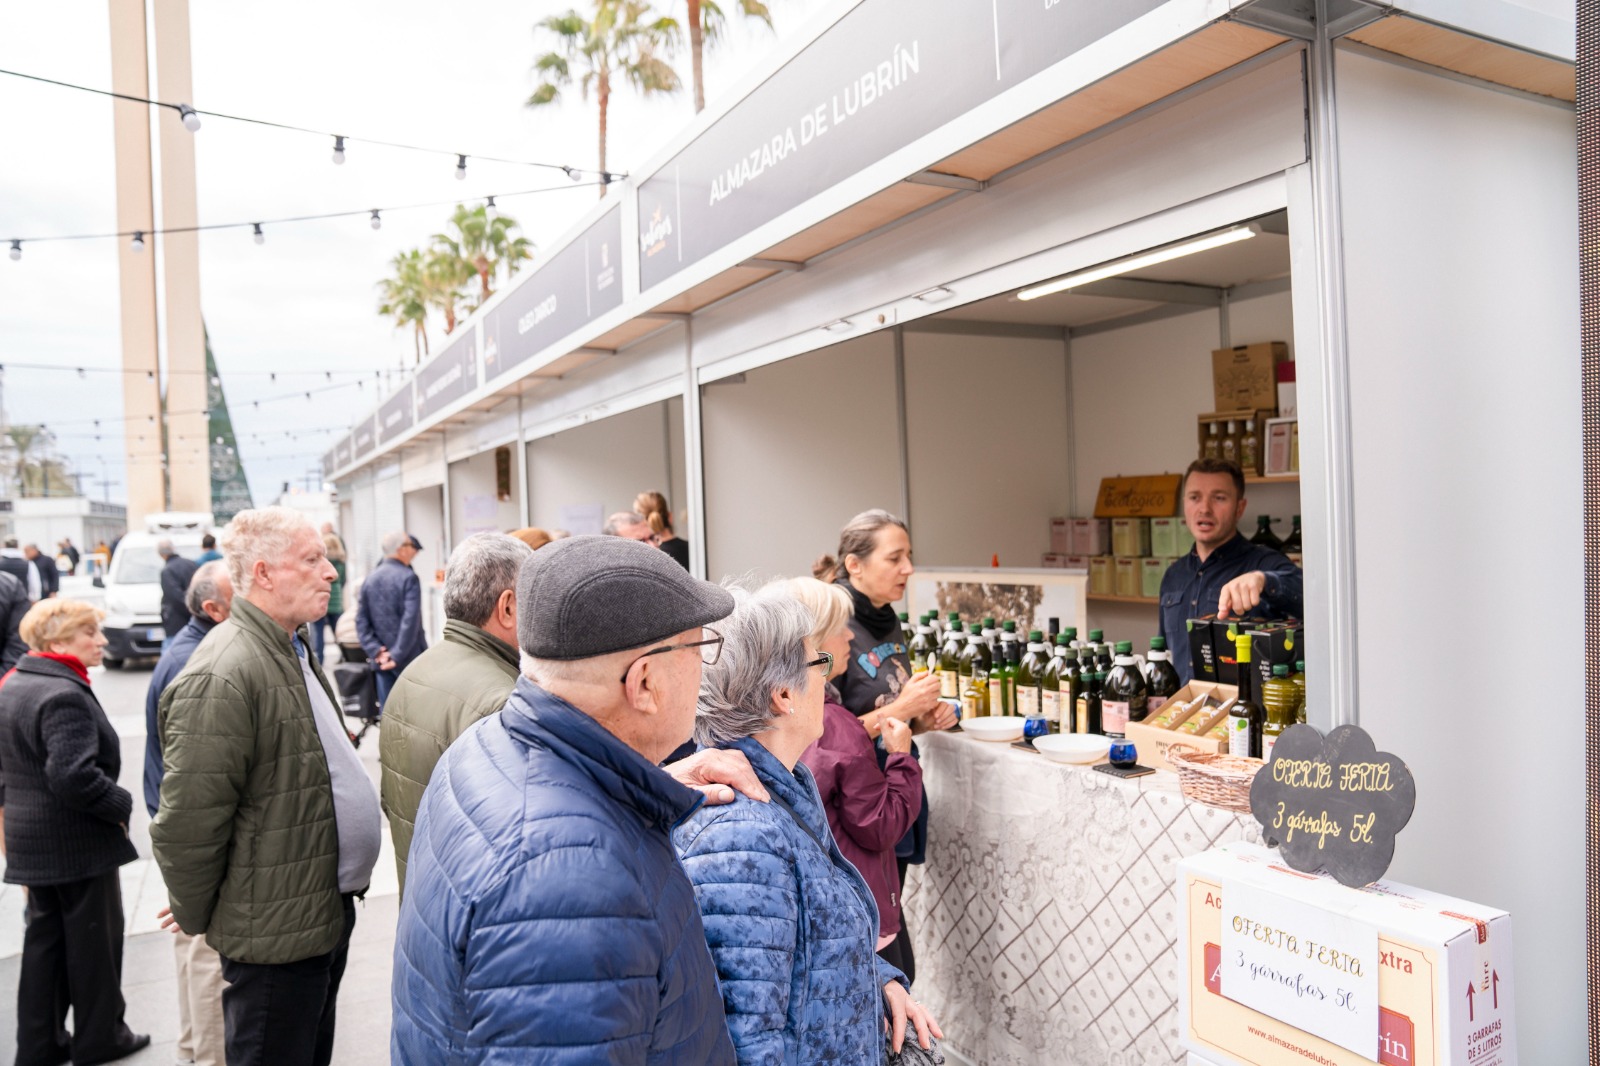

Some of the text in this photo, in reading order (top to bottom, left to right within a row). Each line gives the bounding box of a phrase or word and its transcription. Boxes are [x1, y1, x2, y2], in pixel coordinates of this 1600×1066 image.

[709, 40, 920, 206] ALMAZARA DE LUBRÍN
[1273, 758, 1333, 789] OFERTA
[1273, 801, 1285, 829] 3
[1232, 915, 1300, 955] OFERTA
[1235, 949, 1245, 968] 3
[1379, 950, 1413, 975] xtra
[1467, 1018, 1502, 1046] 3 GARRAFAS
[1467, 1032, 1502, 1060] DE 5 LITROS
